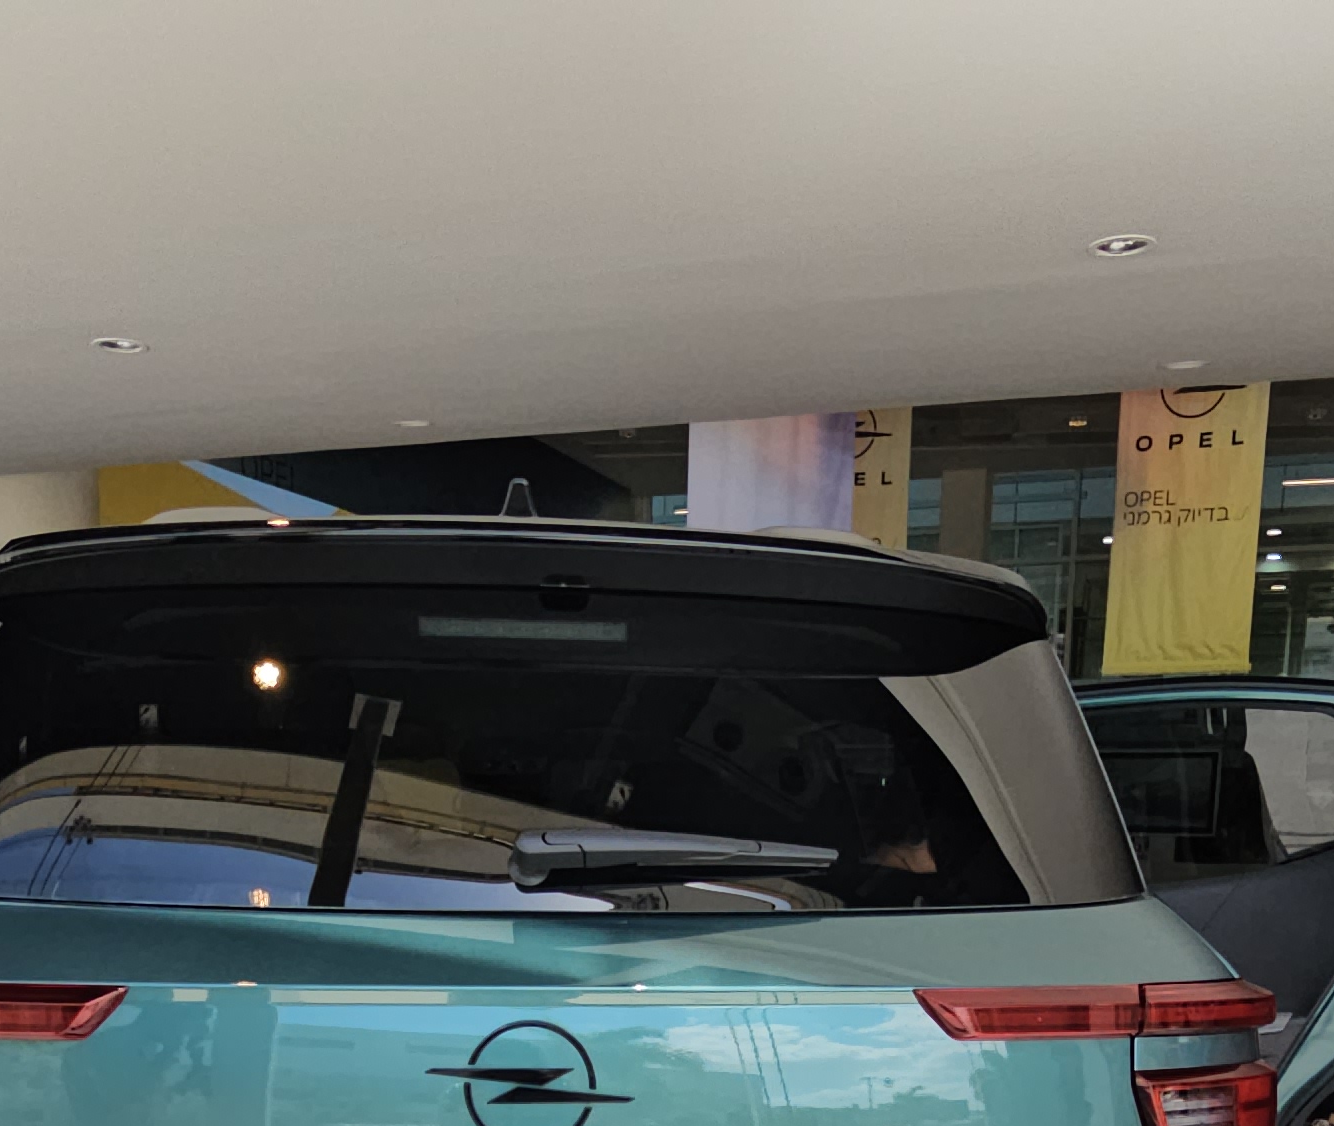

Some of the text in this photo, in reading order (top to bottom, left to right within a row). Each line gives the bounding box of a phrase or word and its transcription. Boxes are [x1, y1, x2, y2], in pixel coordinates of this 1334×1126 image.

[1136, 430, 1244, 452] OPEL
[854, 472, 893, 486] EL
[1124, 490, 1176, 508] OPEL
[1123, 507, 1229, 527] בדיוק גרמני
